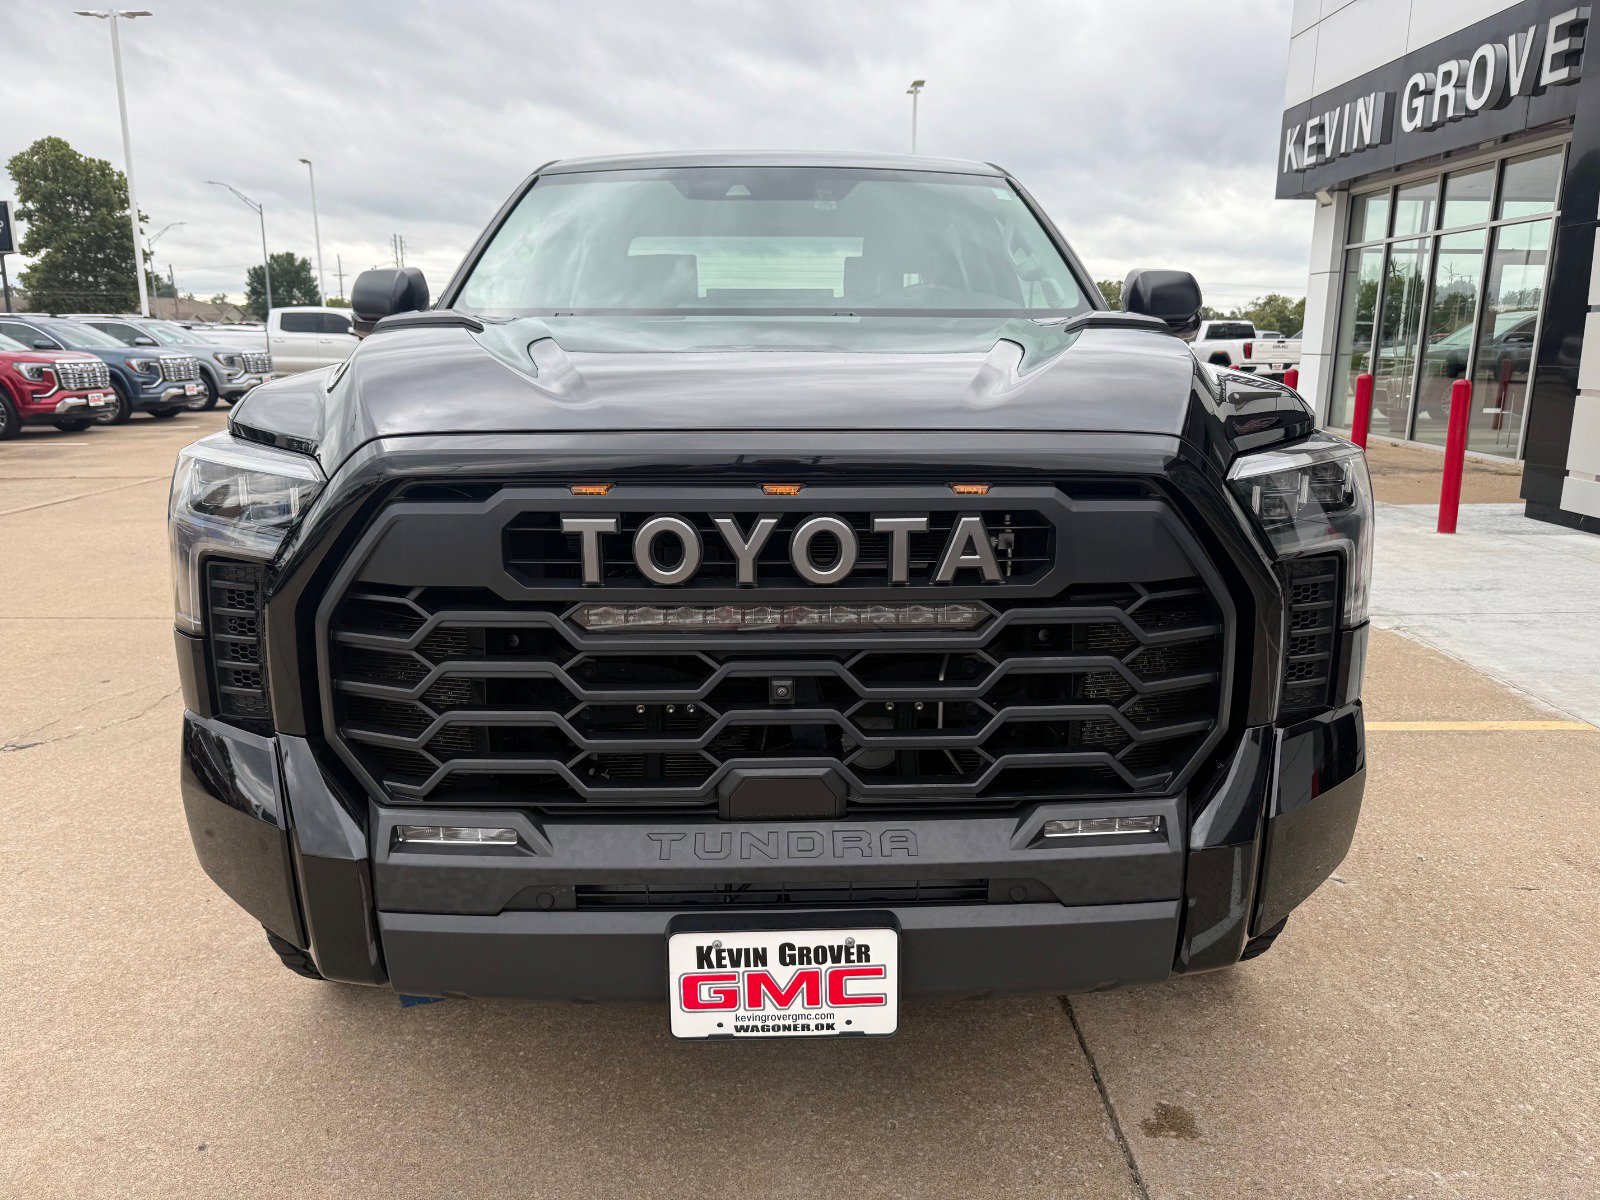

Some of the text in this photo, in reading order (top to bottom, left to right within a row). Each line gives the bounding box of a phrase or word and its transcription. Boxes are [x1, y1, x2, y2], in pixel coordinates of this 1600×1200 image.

[1284, 92, 1380, 173] KEVIN
[560, 515, 1005, 586] TOYOTA
[646, 829, 919, 861] TUNDRA
[696, 942, 871, 969] KEVIN GROVER
[679, 964, 887, 1013] GMC
[735, 1011, 835, 1023] kevingrovergmc.com
